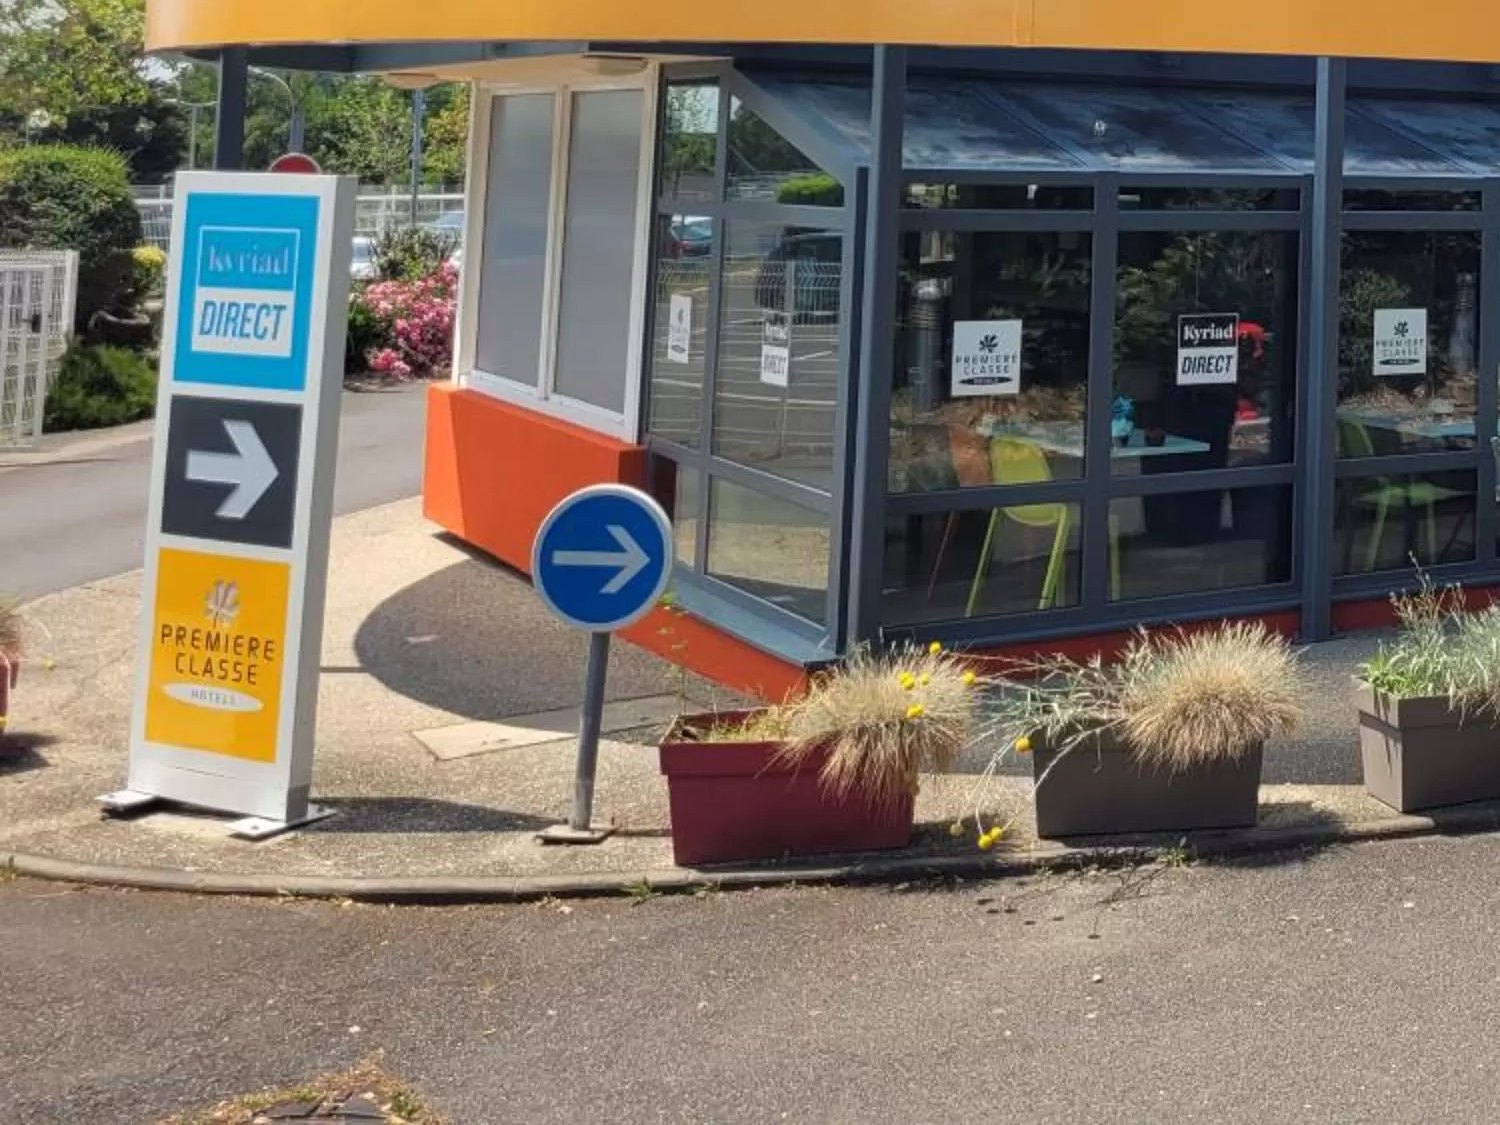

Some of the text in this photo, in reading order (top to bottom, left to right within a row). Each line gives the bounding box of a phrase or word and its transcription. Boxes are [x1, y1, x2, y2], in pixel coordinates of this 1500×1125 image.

[208, 243, 290, 277] Kyriad
[199, 299, 288, 342] DIRECT
[1183, 322, 1234, 346] Kyriad
[1181, 354, 1234, 374] DIRECT
[160, 623, 276, 662] PREMIERE
[175, 652, 258, 685] CLASSE
